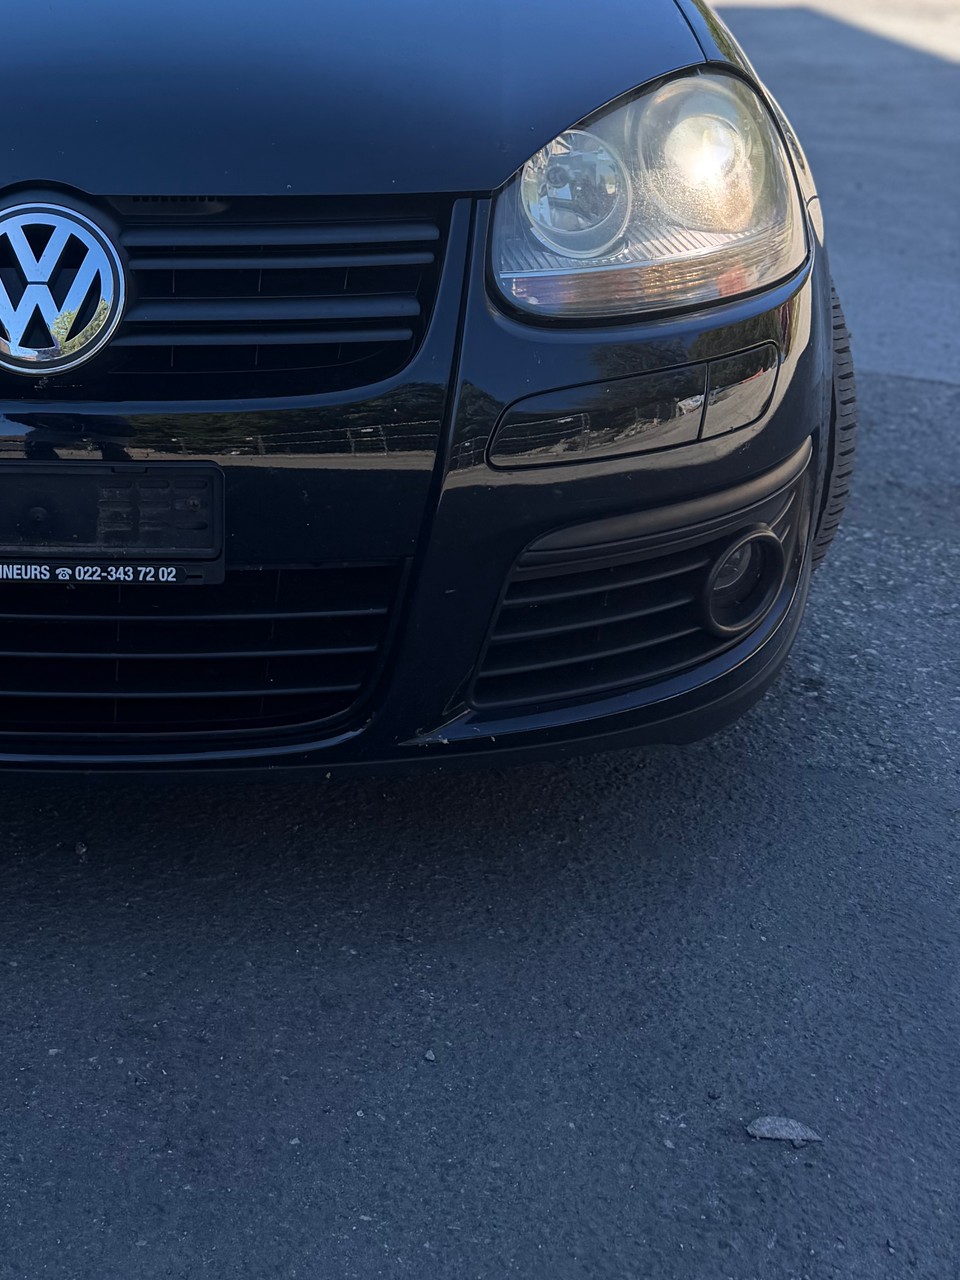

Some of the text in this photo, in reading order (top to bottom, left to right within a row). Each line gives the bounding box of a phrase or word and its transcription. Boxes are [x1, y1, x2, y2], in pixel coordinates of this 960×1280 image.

[75, 566, 134, 581] 022-343
[137, 566, 155, 581] 72
[158, 567, 177, 582] 02
